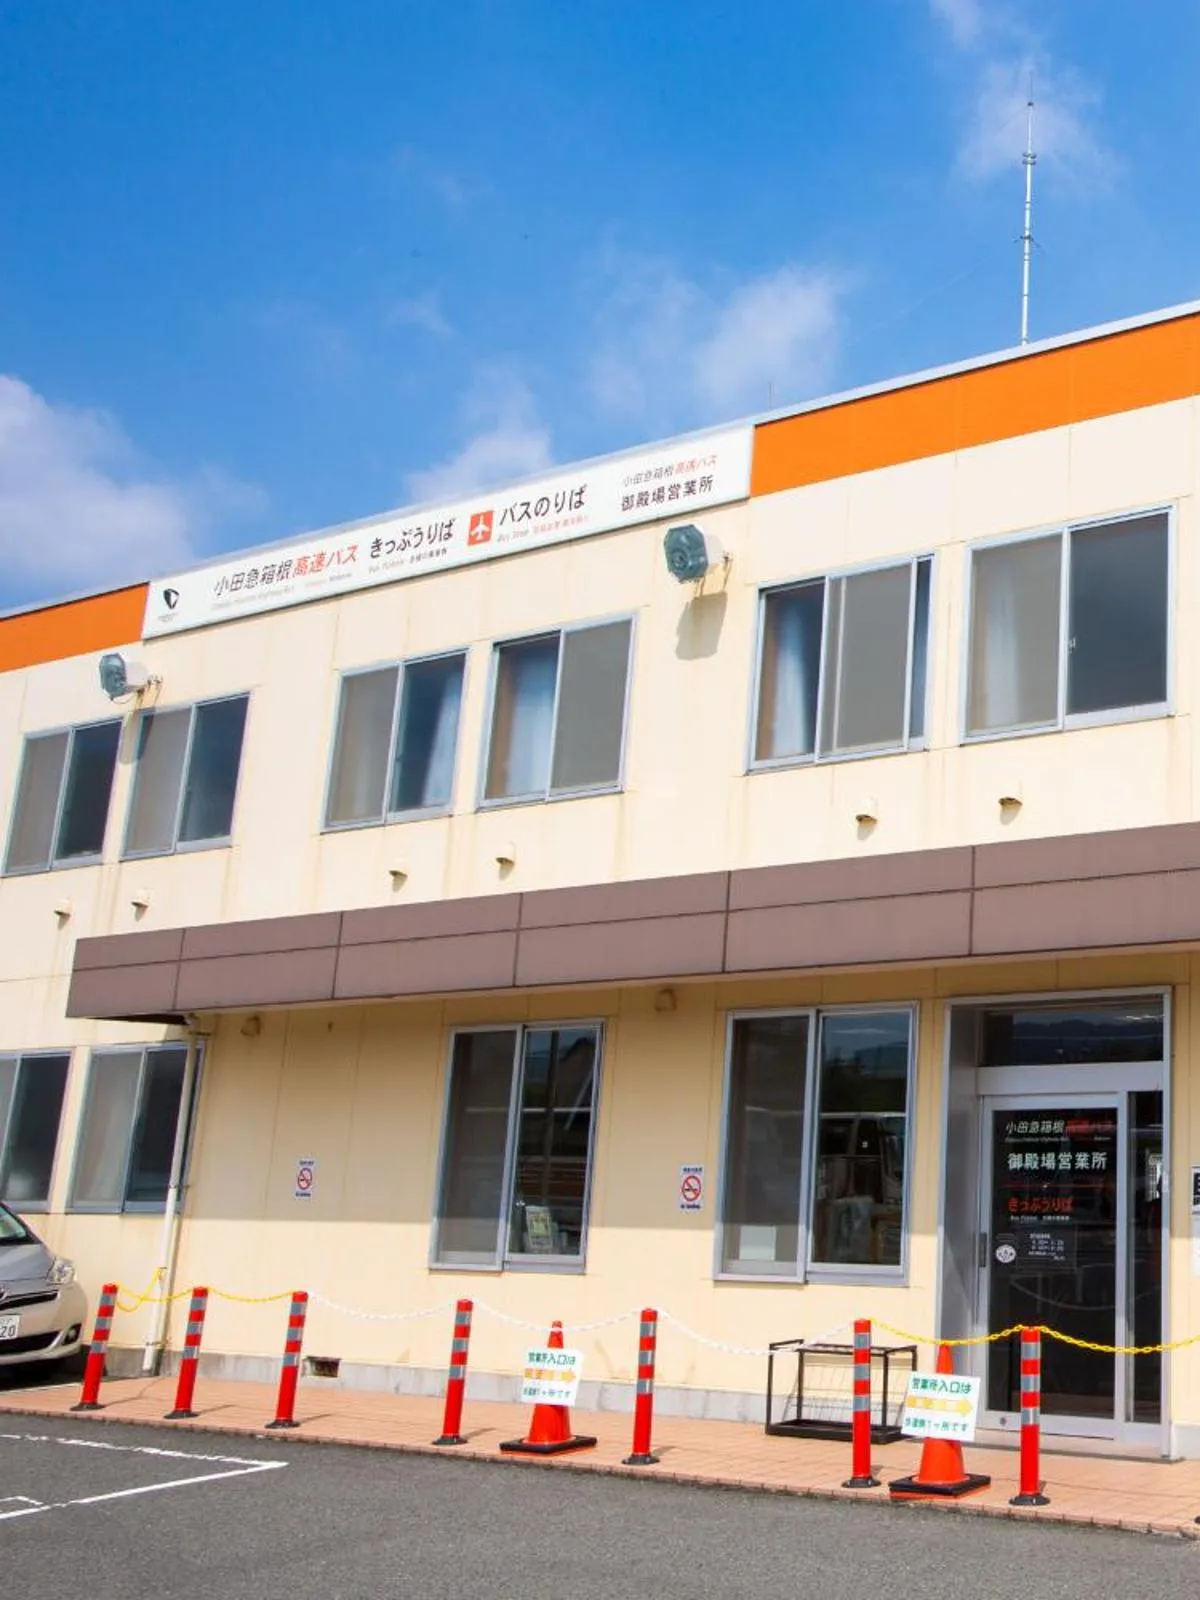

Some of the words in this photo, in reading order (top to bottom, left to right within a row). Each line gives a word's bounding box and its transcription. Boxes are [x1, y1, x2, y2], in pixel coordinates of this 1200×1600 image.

[499, 484, 588, 526] バスのりば
[621, 474, 714, 512] 御殿場営業所
[213, 544, 359, 596] 小田急箱根高速バス
[1008, 1151, 1108, 1170] 御殿場営業所
